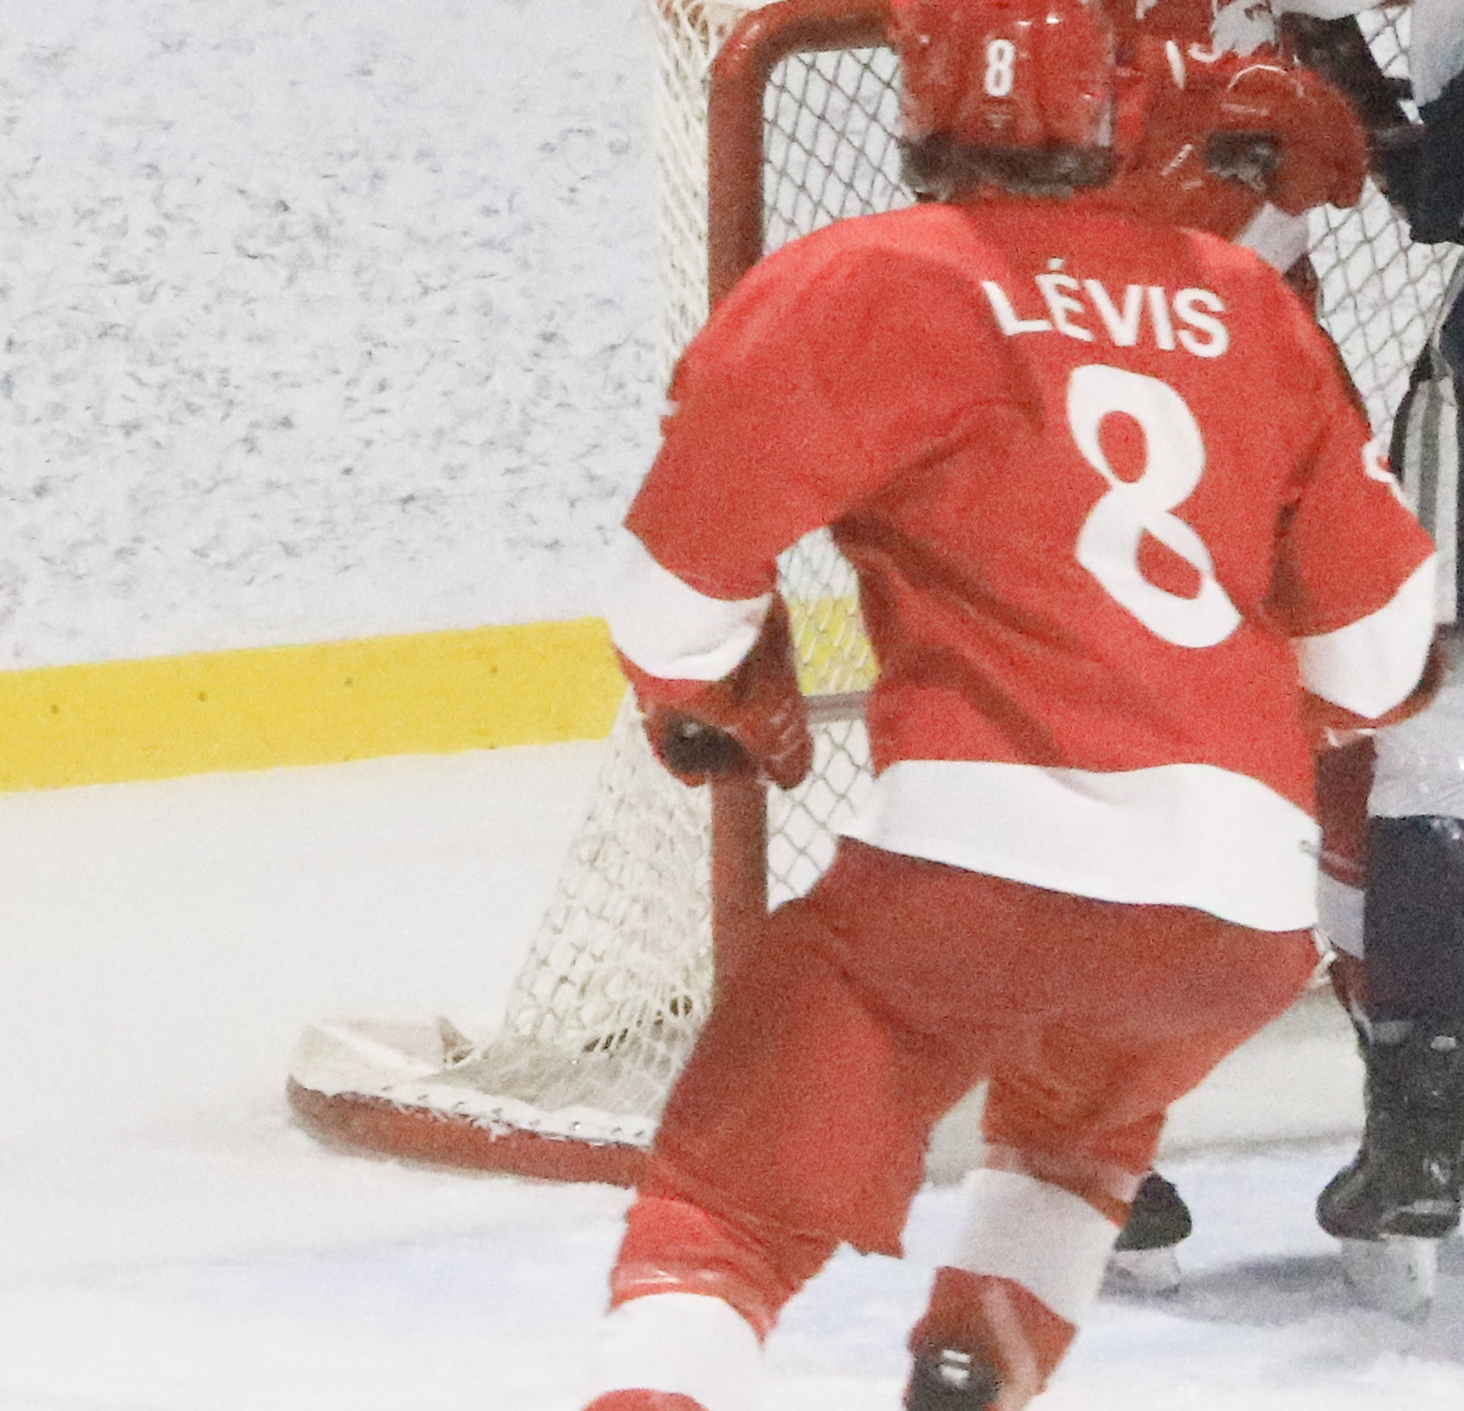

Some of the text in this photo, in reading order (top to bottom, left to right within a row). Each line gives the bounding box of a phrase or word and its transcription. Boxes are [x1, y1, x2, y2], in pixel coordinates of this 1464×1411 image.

[984, 38, 1017, 97] 8
[981, 255, 1231, 358] LÉVIS
[1065, 363, 1243, 649] 8
